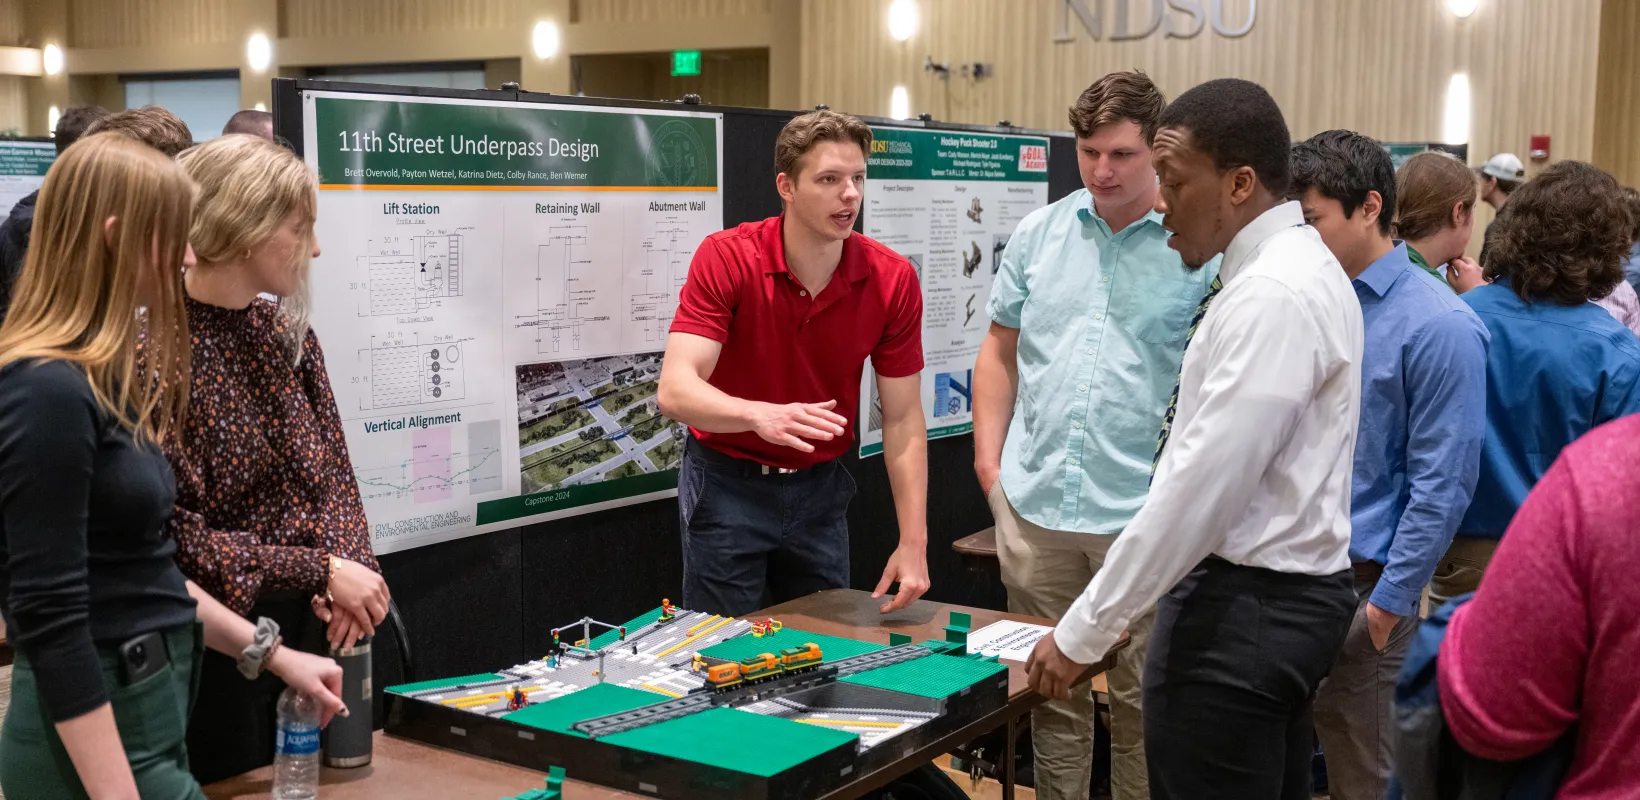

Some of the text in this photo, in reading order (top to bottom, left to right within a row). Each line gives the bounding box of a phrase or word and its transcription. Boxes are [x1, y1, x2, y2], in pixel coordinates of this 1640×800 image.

[1053, 0, 1257, 43] NDSU
[340, 130, 598, 162] 11th Street Underpass Design
[344, 168, 364, 177] Brett
[366, 168, 400, 179] Overvold,
[402, 169, 426, 178] Payton
[429, 170, 457, 179] Wetzel,
[458, 170, 484, 178] Katrina
[486, 170, 506, 180] Dietz,
[507, 171, 526, 180] Colby
[528, 172, 548, 180] Rance,
[384, 203, 440, 214] Lift Station
[535, 203, 600, 215] Retaining Wall
[649, 201, 706, 211] Abutment Wall
[364, 412, 461, 433] Vertical Alignment
[525, 491, 570, 506] Capstone 2024
[376, 515, 471, 539] ENVIRONMENTAL ENGINEERING
[395, 514, 444, 528] CONSTRUCTION
[445, 511, 459, 519] AND
